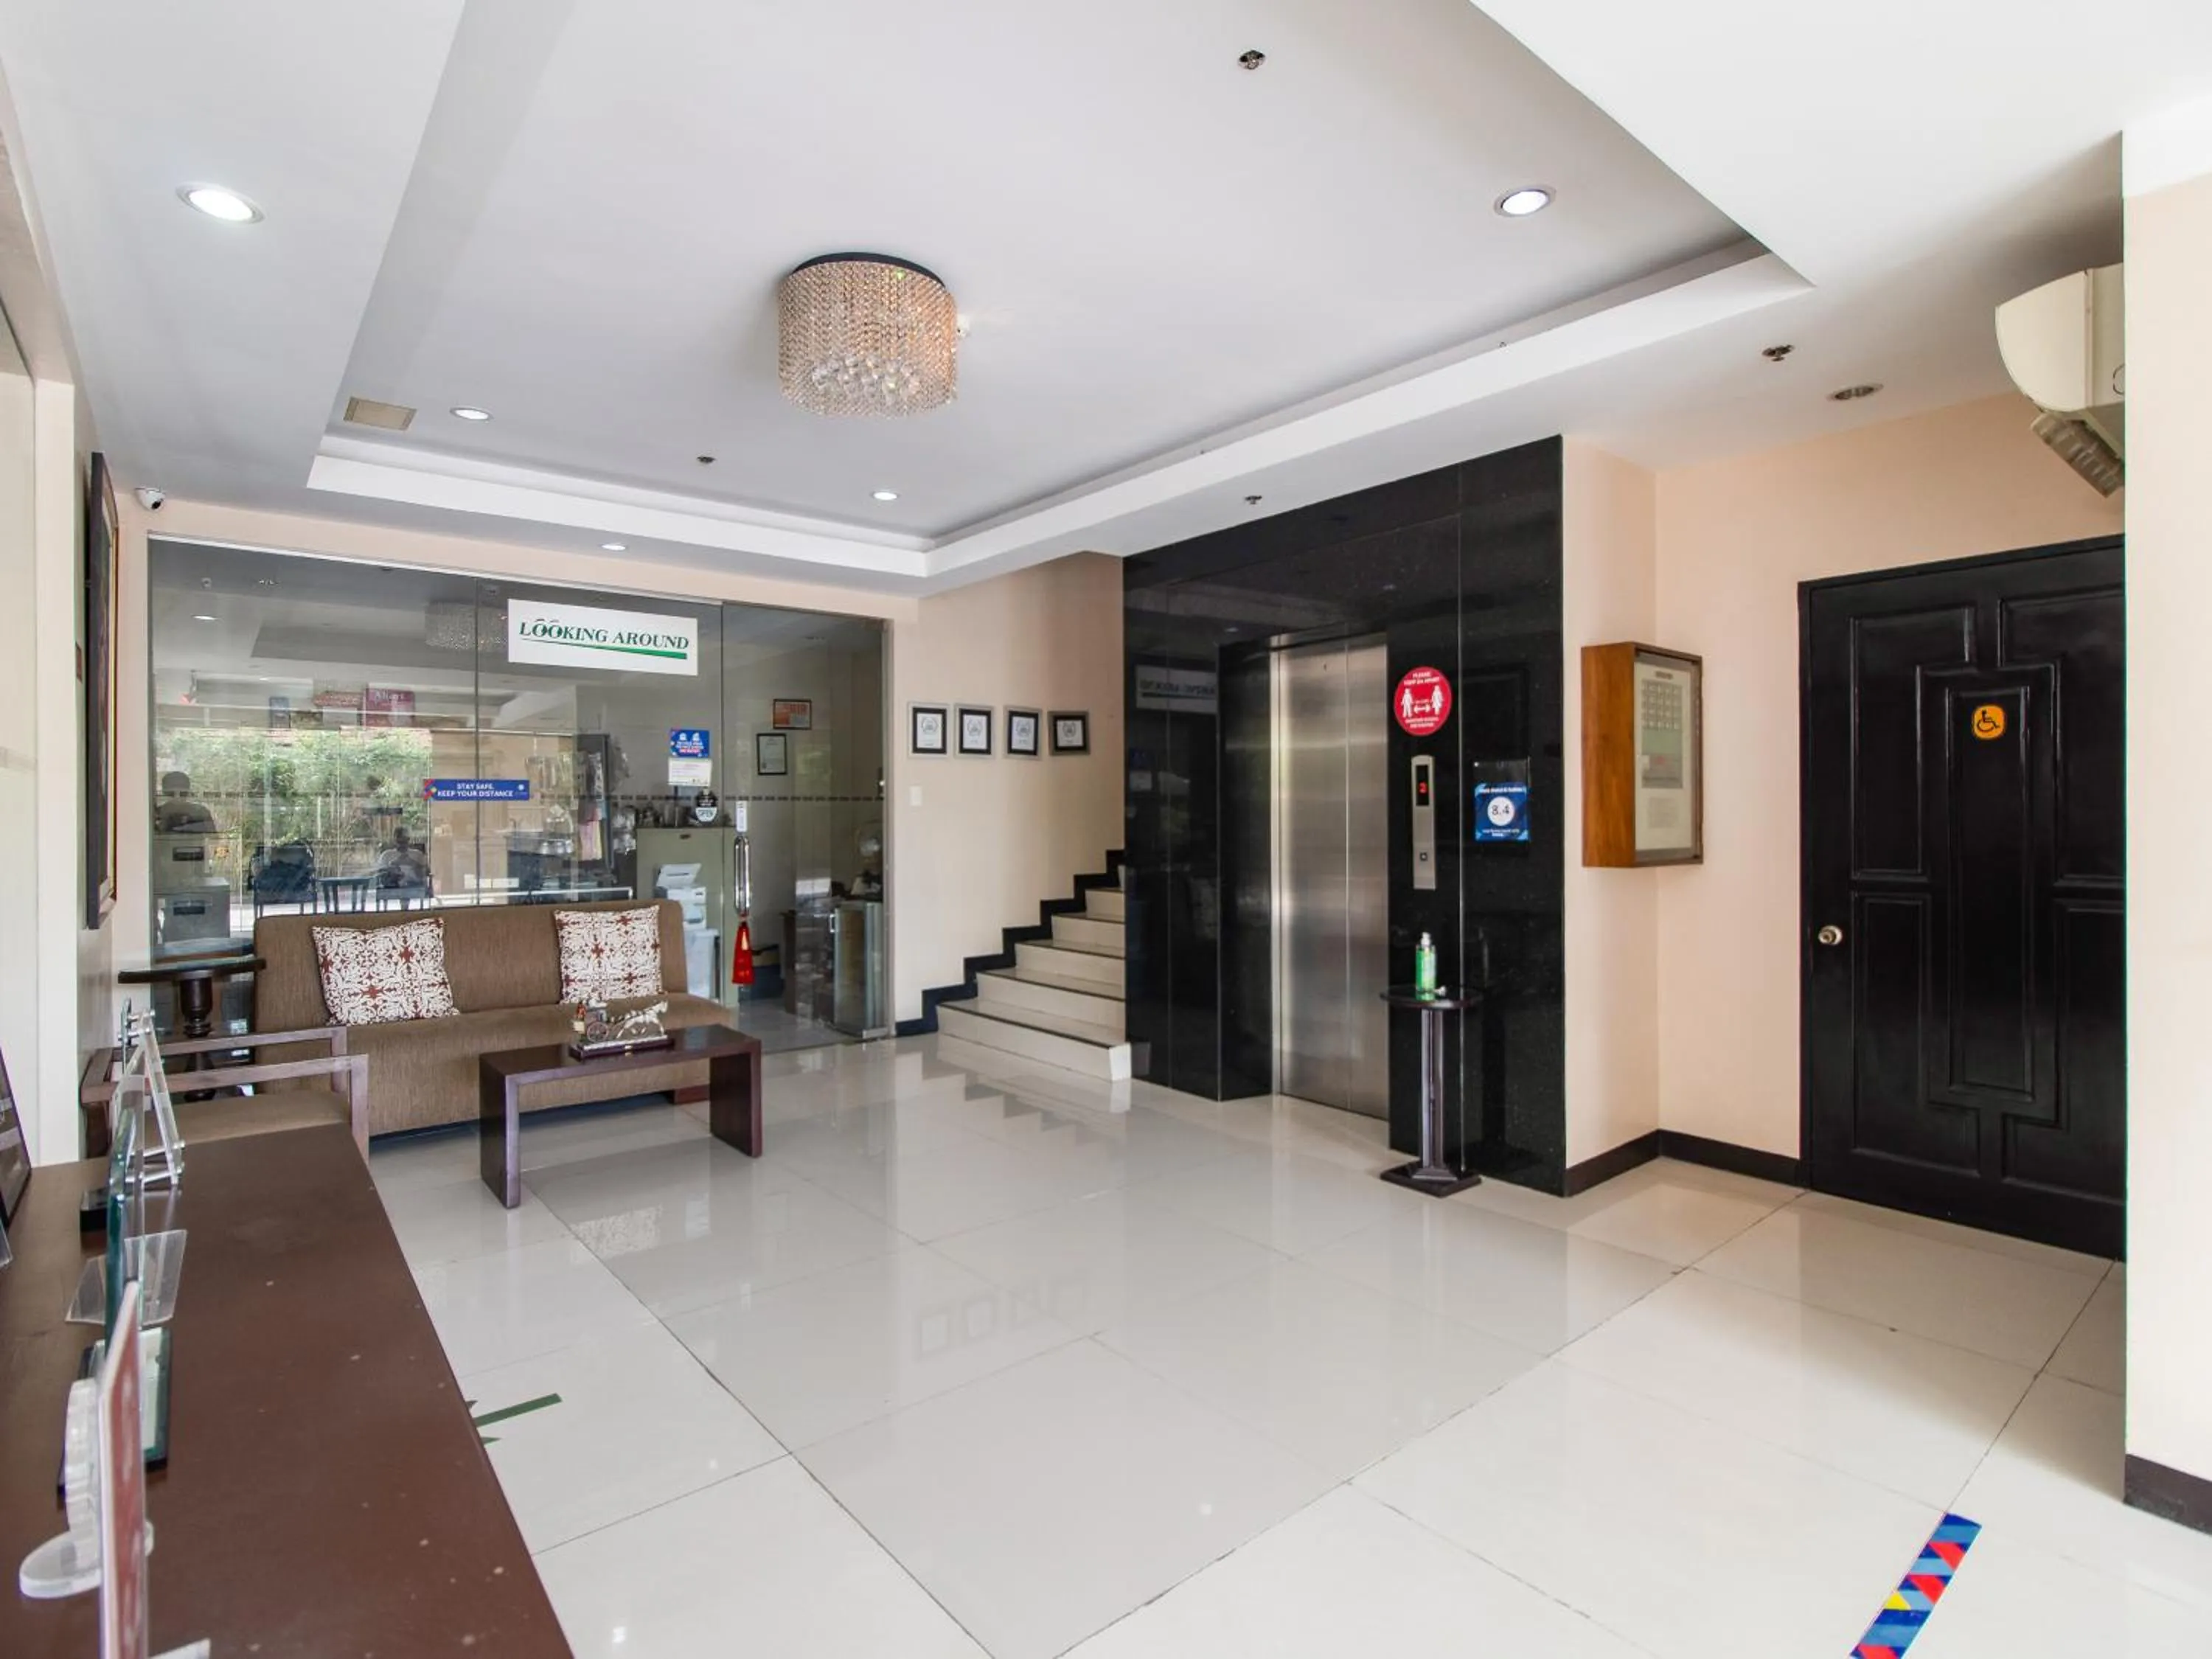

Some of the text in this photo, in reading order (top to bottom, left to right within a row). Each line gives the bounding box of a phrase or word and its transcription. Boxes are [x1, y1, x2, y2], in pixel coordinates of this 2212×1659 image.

[519, 619, 689, 650] LOOKING AROUND
[1492, 804, 1510, 815] 8.4
